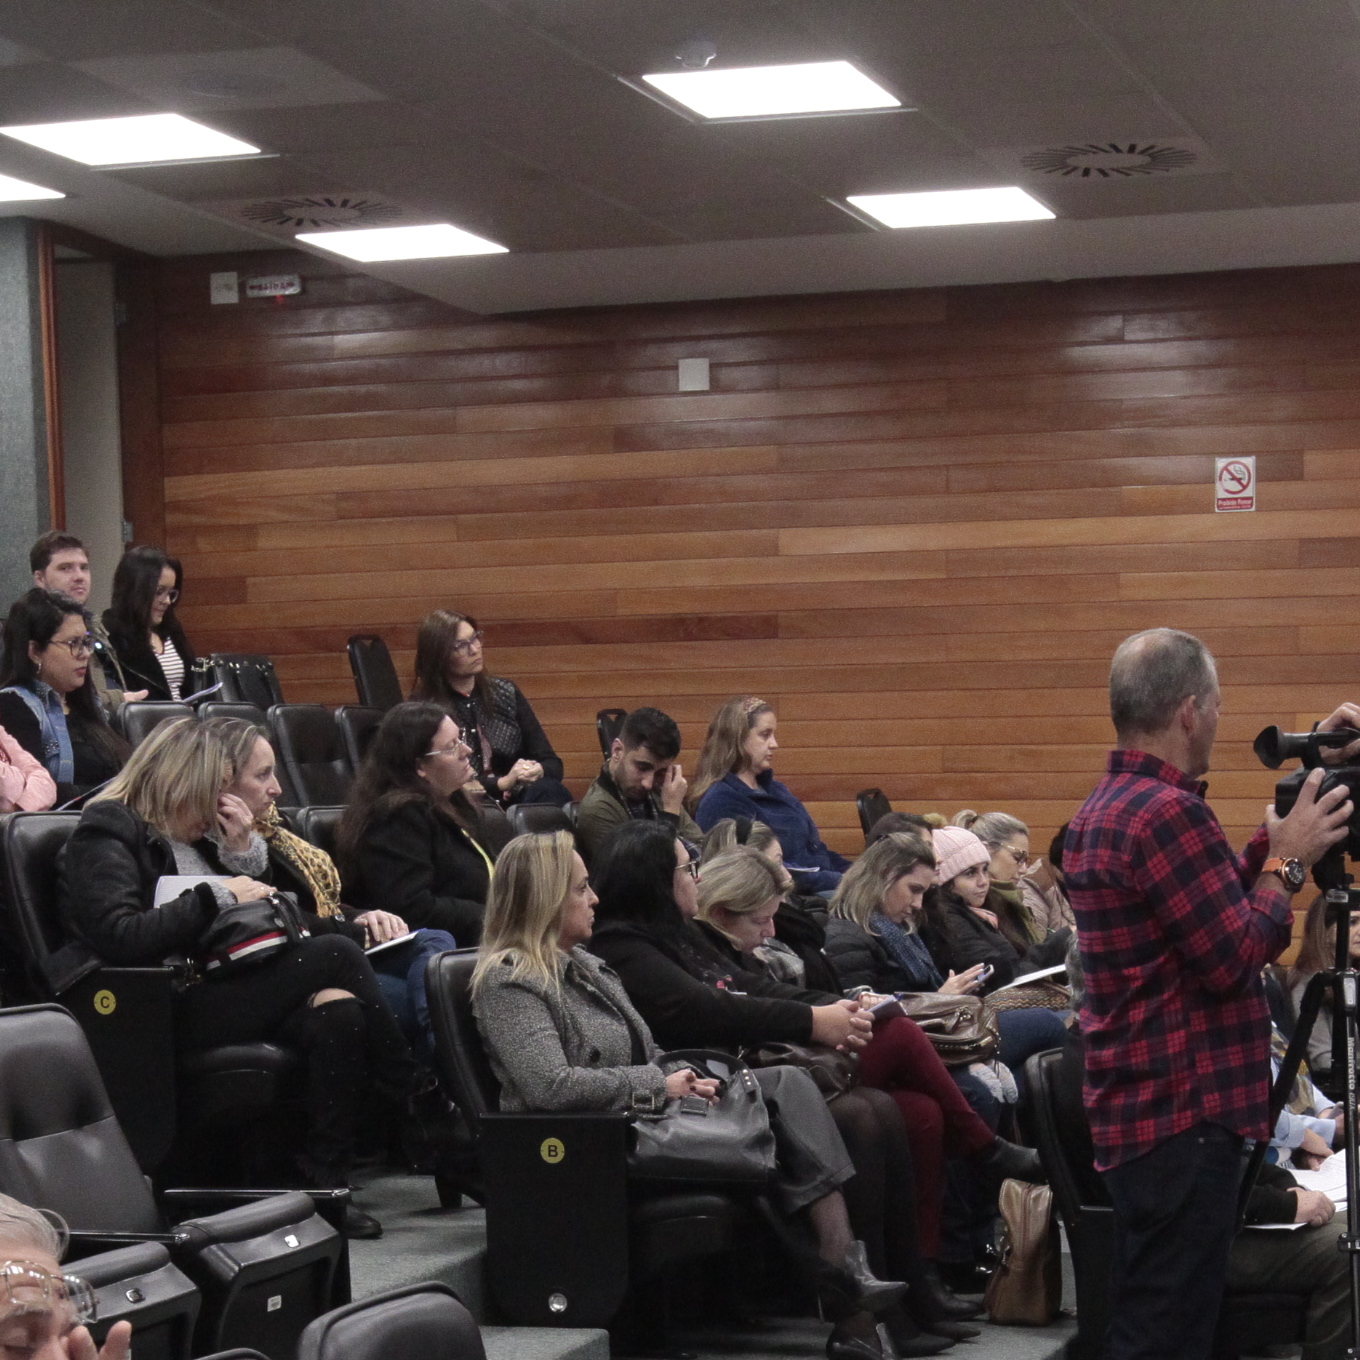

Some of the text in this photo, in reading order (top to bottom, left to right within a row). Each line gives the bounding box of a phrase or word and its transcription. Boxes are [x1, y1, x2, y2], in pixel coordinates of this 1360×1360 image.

[100, 996, 110, 1008] C
[1348, 1037, 1356, 1090] Manfrotto
[548, 1145, 558, 1157] B
